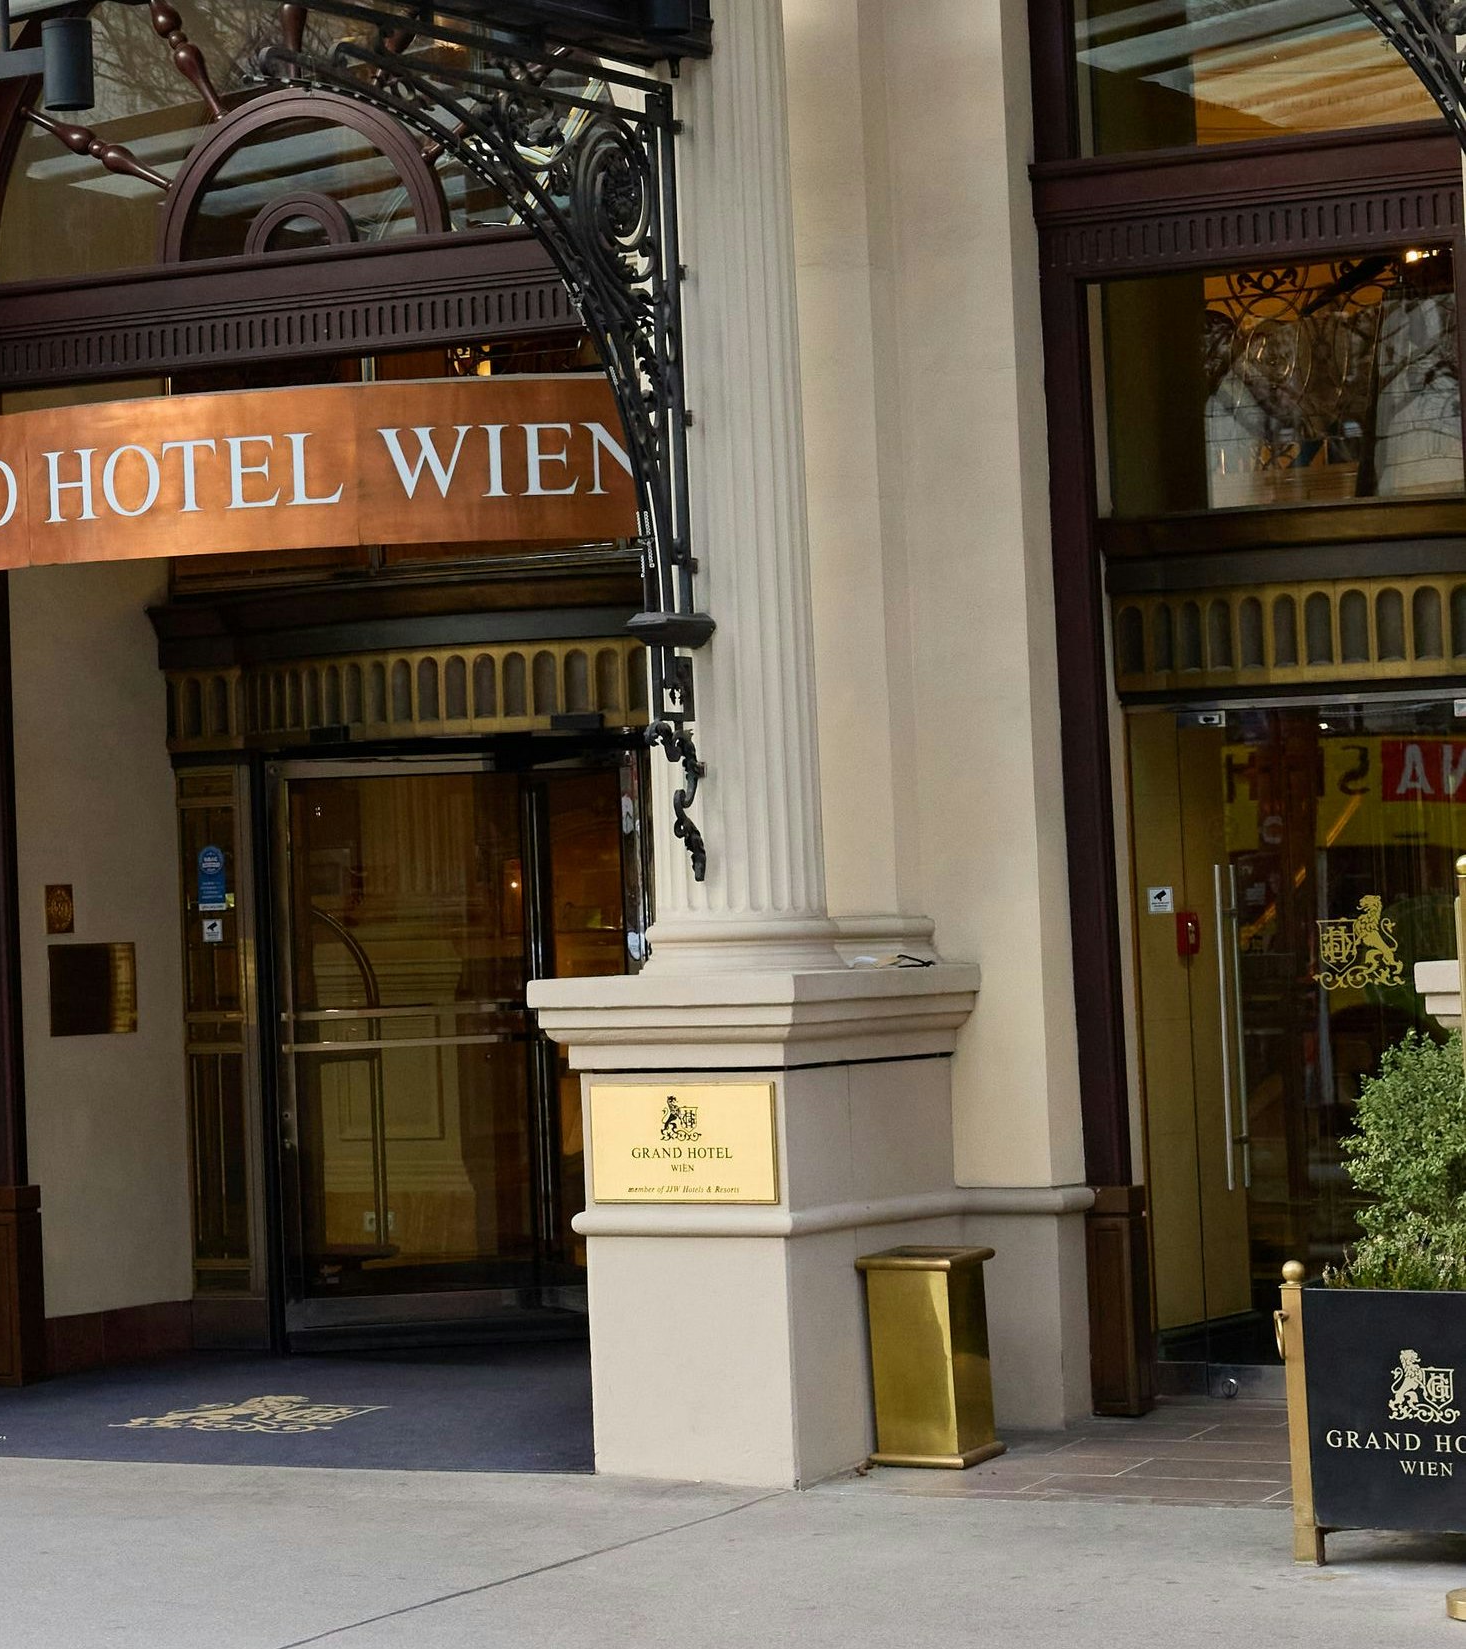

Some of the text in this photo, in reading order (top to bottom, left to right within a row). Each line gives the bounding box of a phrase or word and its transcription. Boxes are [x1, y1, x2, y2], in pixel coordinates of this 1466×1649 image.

[42, 432, 344, 524] HOTEL
[631, 1147, 733, 1159] GRAND HOTEL
[670, 1164, 695, 1173] WIEN
[628, 1185, 740, 1194] member of JJW Hotels & Resorts
[1326, 1429, 1421, 1451] GRAND
[1399, 1460, 1453, 1477] WIEN
